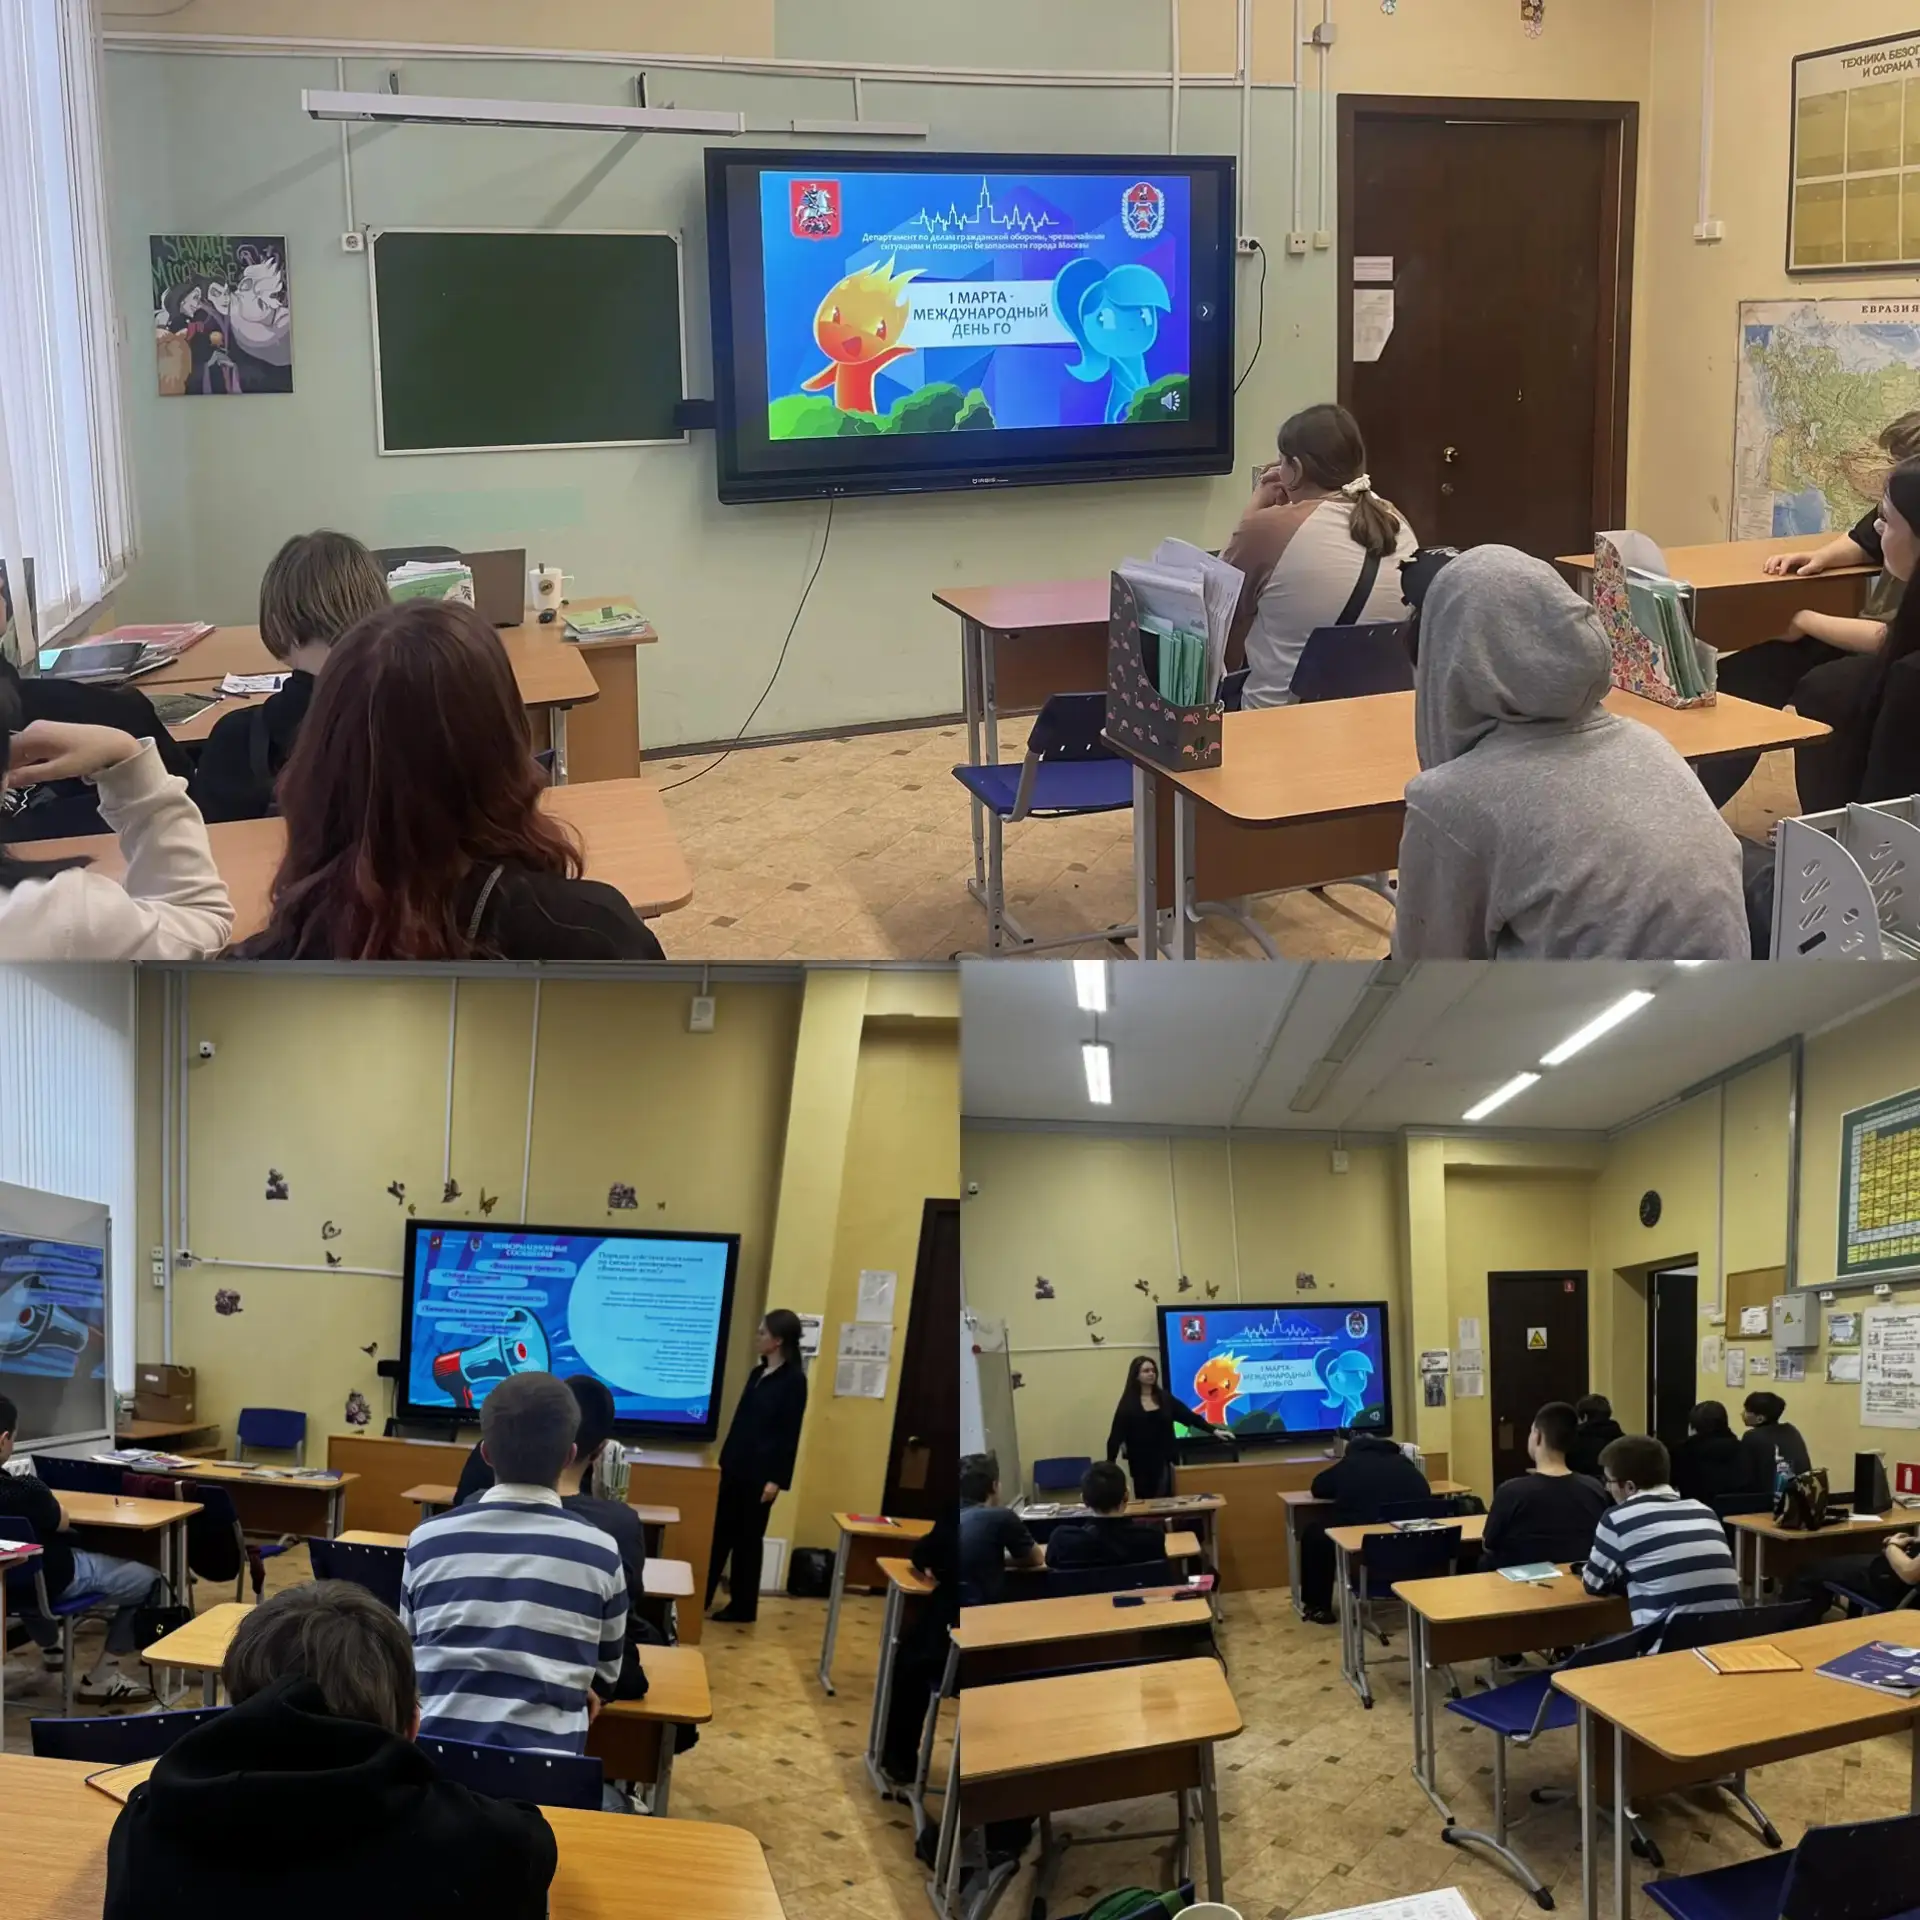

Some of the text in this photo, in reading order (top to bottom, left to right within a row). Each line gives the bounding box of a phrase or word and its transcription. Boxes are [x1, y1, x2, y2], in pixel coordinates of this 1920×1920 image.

[1841, 52, 1887, 70] ТЕХНИКА
[1863, 67, 1870, 78] И
[1872, 59, 1913, 76] ОХРАНА
[862, 232, 918, 243] Департамент
[930, 234, 956, 242] делам
[957, 232, 1009, 243] гражданской
[932, 242, 973, 252] пожарной
[974, 241, 1028, 251] безопасности
[1029, 242, 1057, 252] города
[1058, 241, 1089, 250] Москвы
[948, 291, 954, 304] 1
[957, 291, 1007, 304] МАРТА
[913, 303, 1049, 323] МЕЖДУНАРОДНЫЙ
[1861, 304, 1919, 313] ЕВРАЗИЯ
[952, 322, 1012, 339] ДЕНЬ ГО
